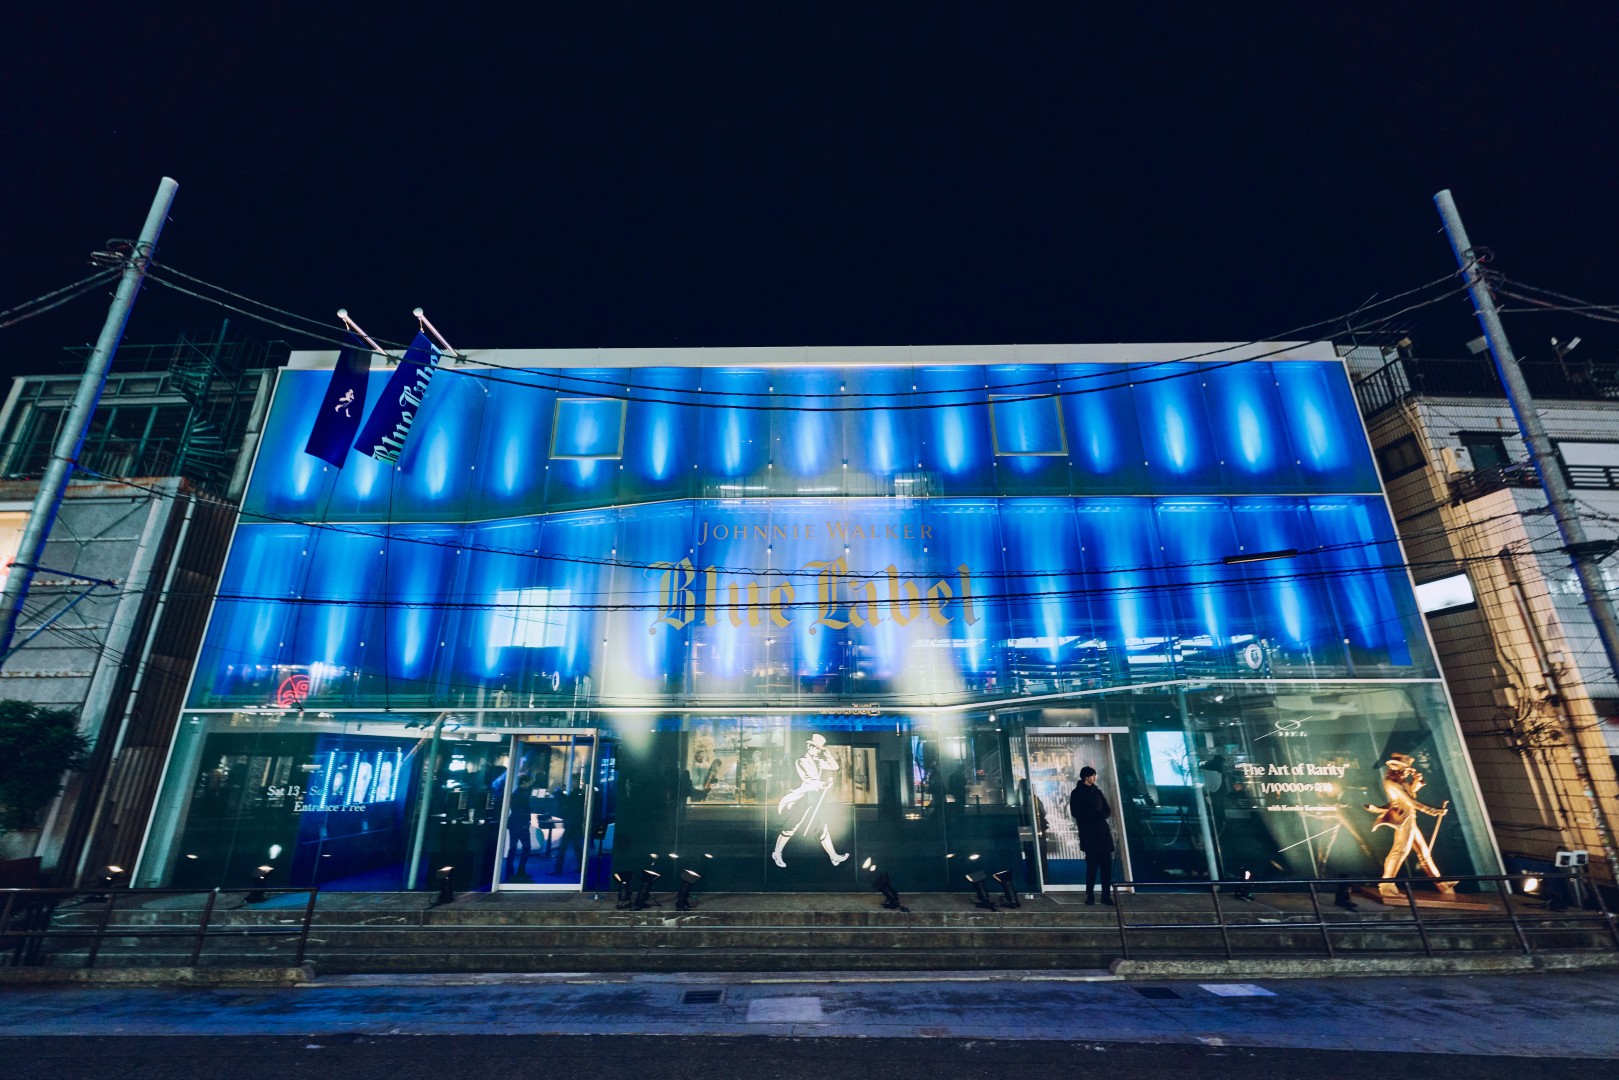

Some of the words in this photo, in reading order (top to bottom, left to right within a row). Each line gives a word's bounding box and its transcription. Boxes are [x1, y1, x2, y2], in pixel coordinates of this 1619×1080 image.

[698, 521, 816, 546] JOHNNIE
[826, 521, 933, 540] WALKER
[644, 556, 797, 635] Blue
[802, 555, 981, 635] Label
[1268, 763, 1290, 776] Art
[1291, 763, 1305, 776] of
[267, 785, 286, 797] Sat
[287, 785, 300, 797] 13
